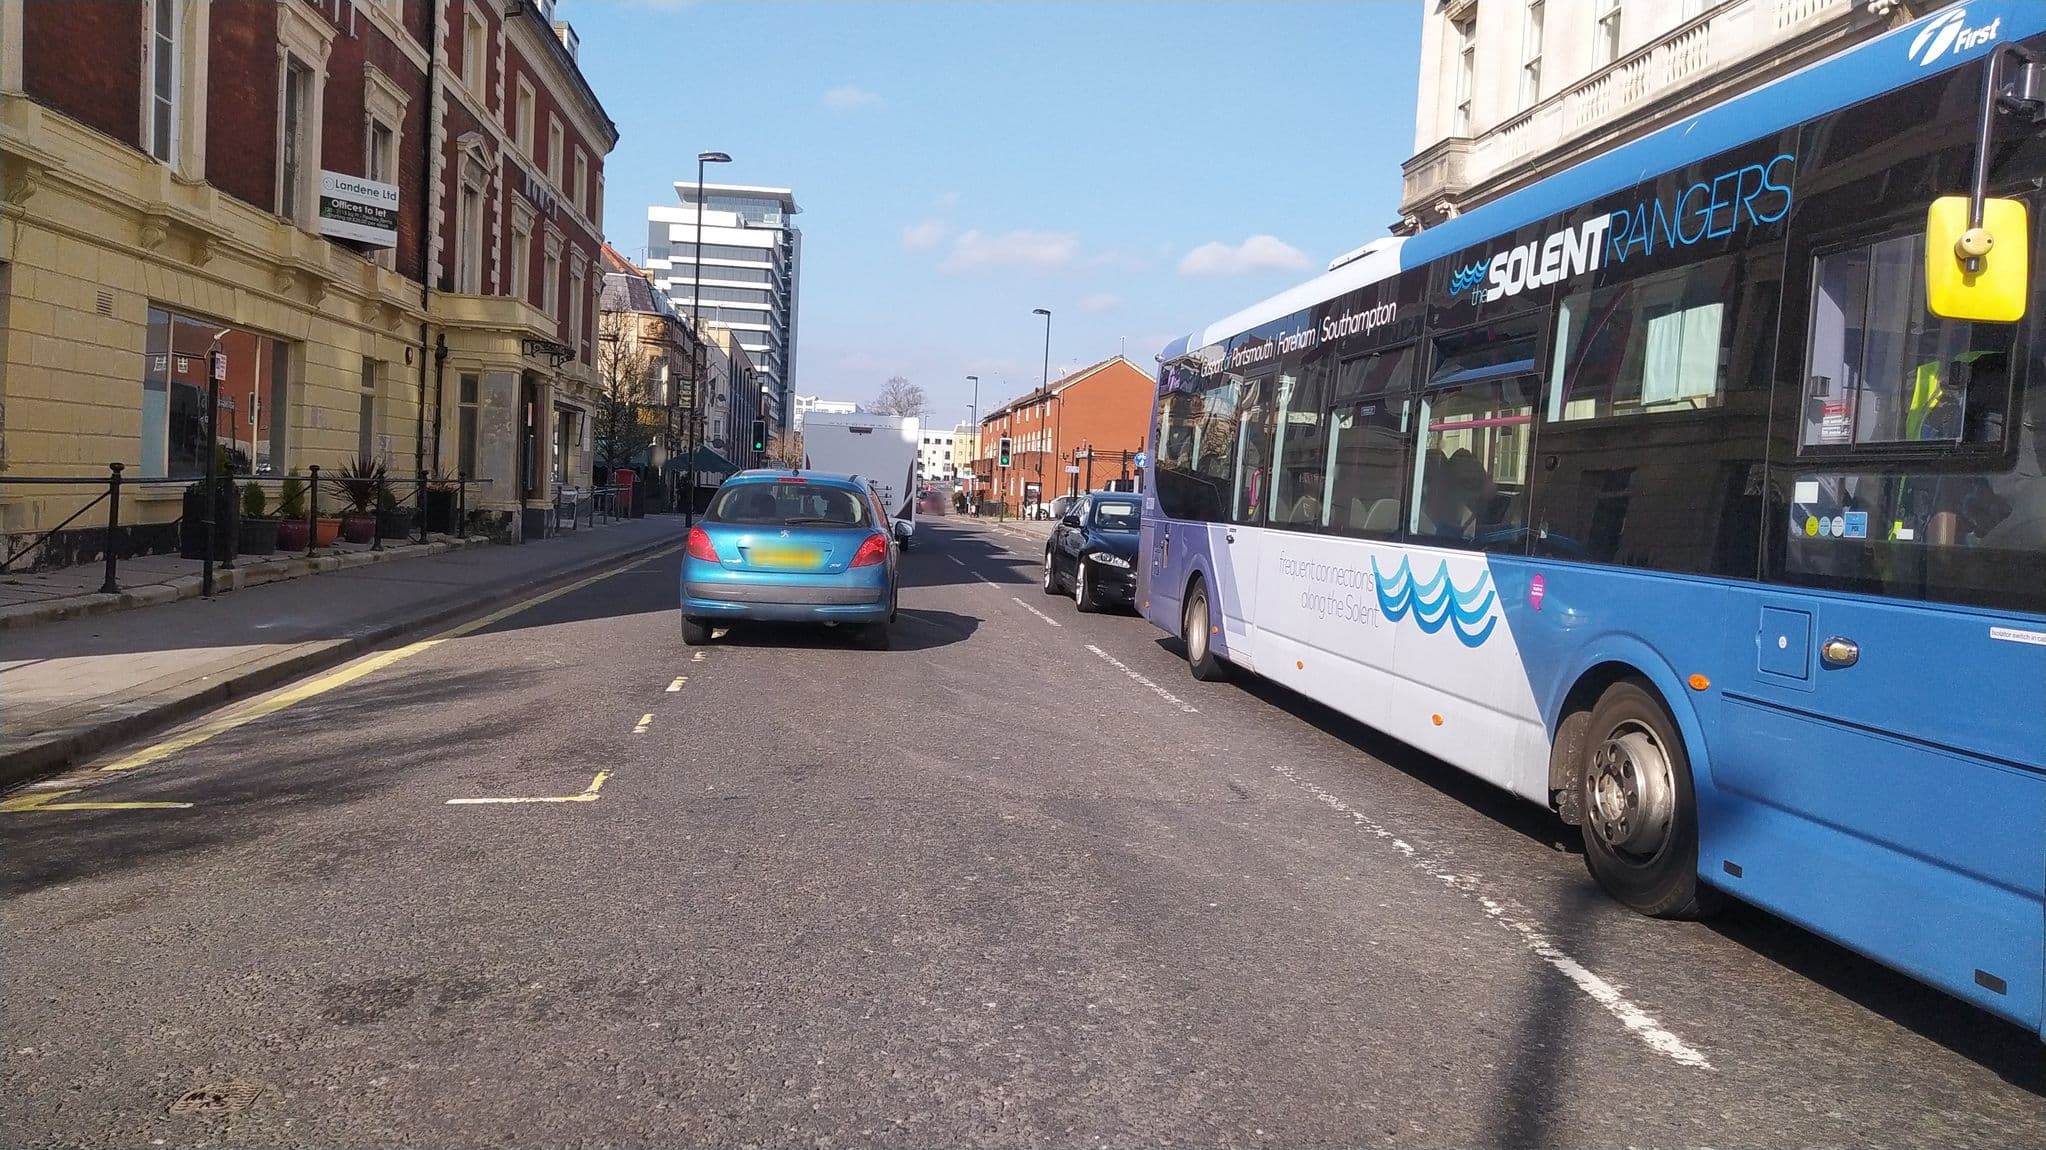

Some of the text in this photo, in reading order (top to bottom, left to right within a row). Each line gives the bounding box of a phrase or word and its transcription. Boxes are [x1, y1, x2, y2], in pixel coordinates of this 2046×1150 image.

[1953, 17, 2000, 54] First
[331, 199, 362, 213] Offices
[364, 205, 374, 215] to
[375, 208, 387, 218] let
[335, 179, 380, 197] Landene
[382, 189, 397, 201] Ltd
[1471, 154, 1794, 306] the SOLENT RANGERS
[1201, 354, 1225, 380] Gosport
[1231, 335, 1274, 369] Portsmouth
[1277, 326, 1316, 356] Fareham
[1321, 301, 1397, 343] Southampton
[1280, 550, 1374, 592] frequent connections
[1301, 584, 1380, 628] along the Solent
